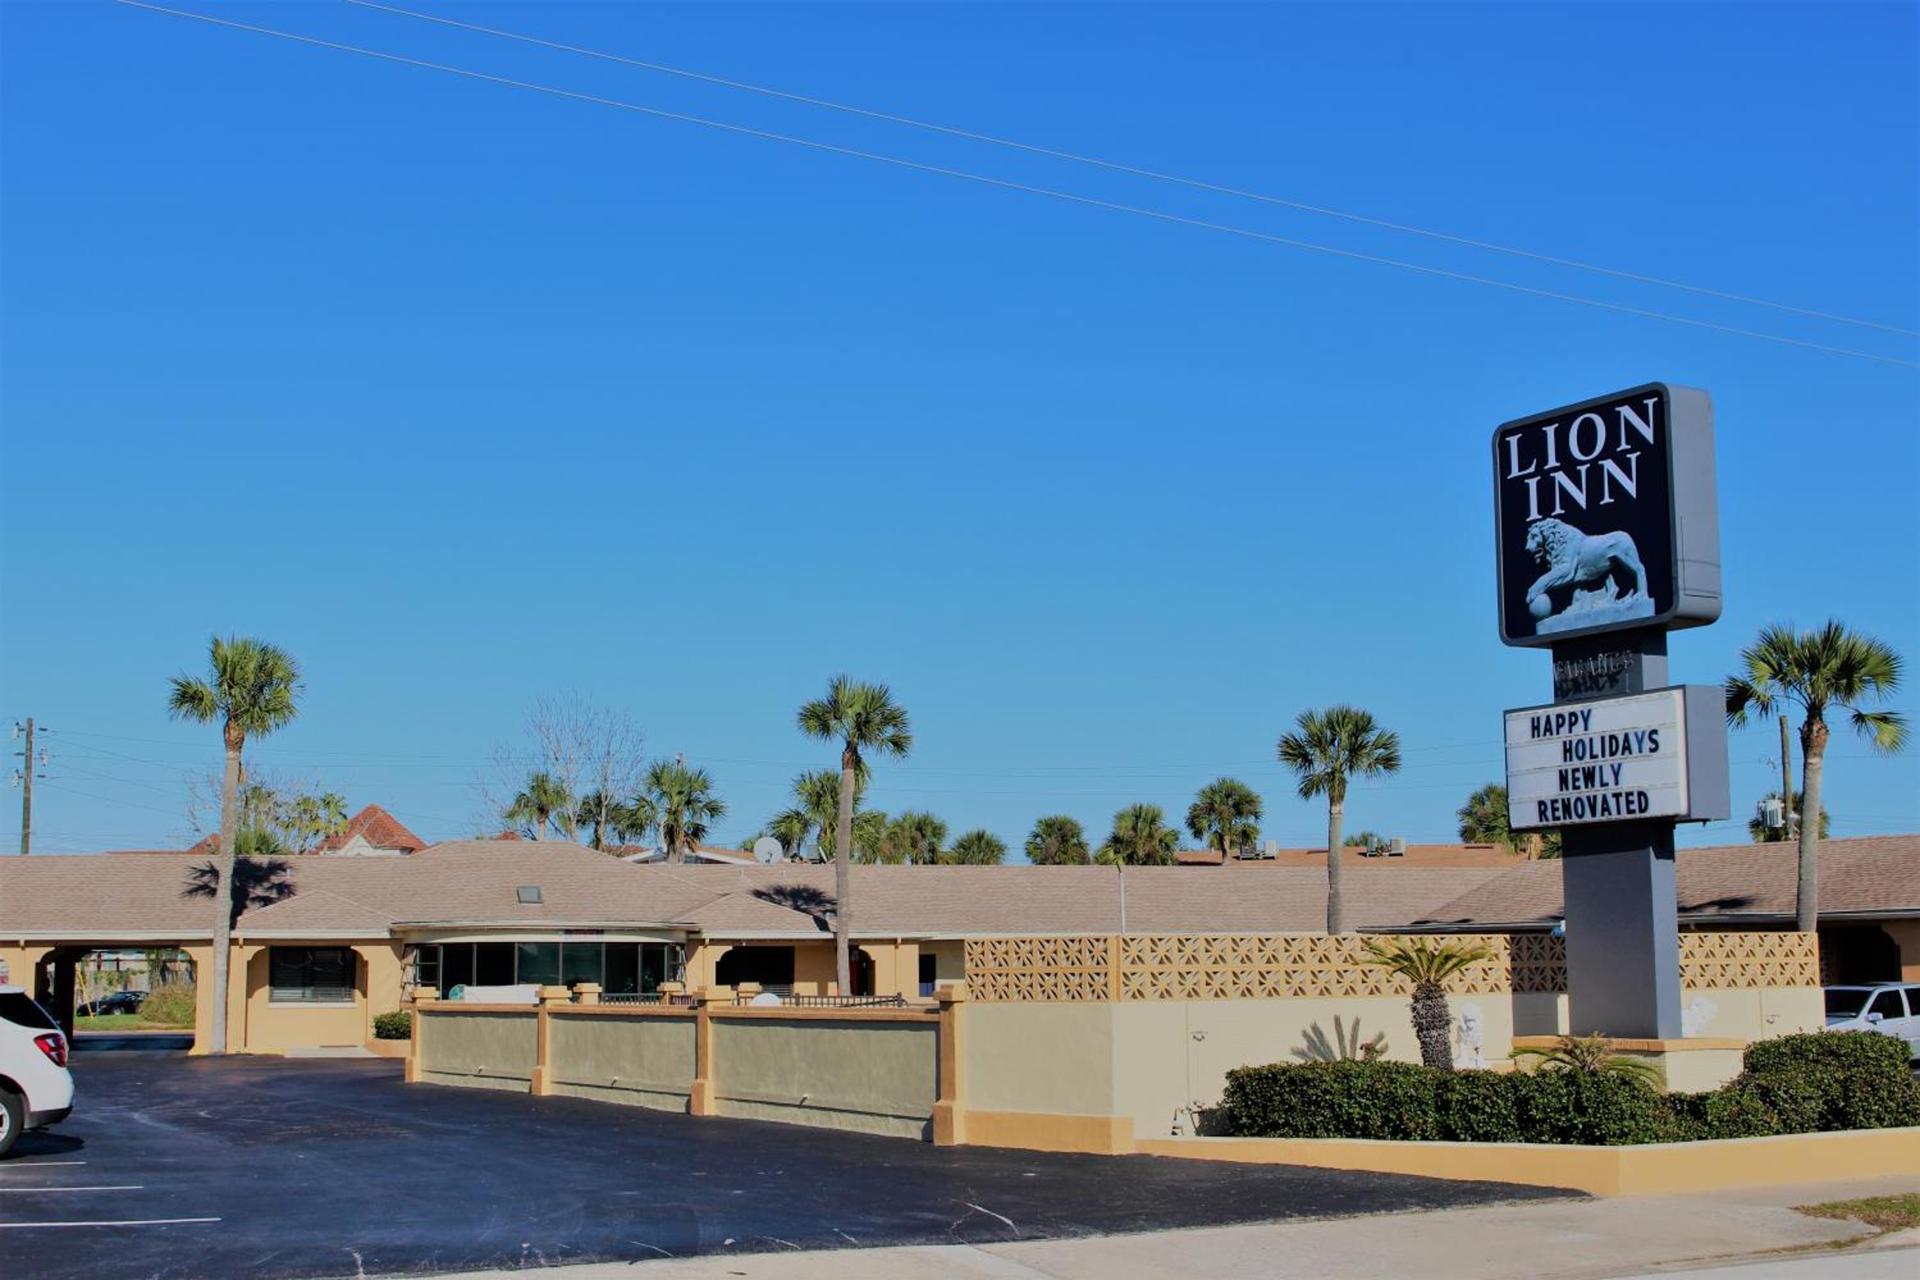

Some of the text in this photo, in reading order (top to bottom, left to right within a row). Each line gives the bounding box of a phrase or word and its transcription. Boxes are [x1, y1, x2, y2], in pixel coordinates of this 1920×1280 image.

[1506, 397, 1658, 479] LION
[1525, 452, 1641, 522] INN
[1531, 709, 1592, 738] HAPPY
[1563, 729, 1660, 762] HOLIDAYS
[1559, 764, 1622, 792] NEWLY
[1538, 791, 1649, 823] RENOVATED
